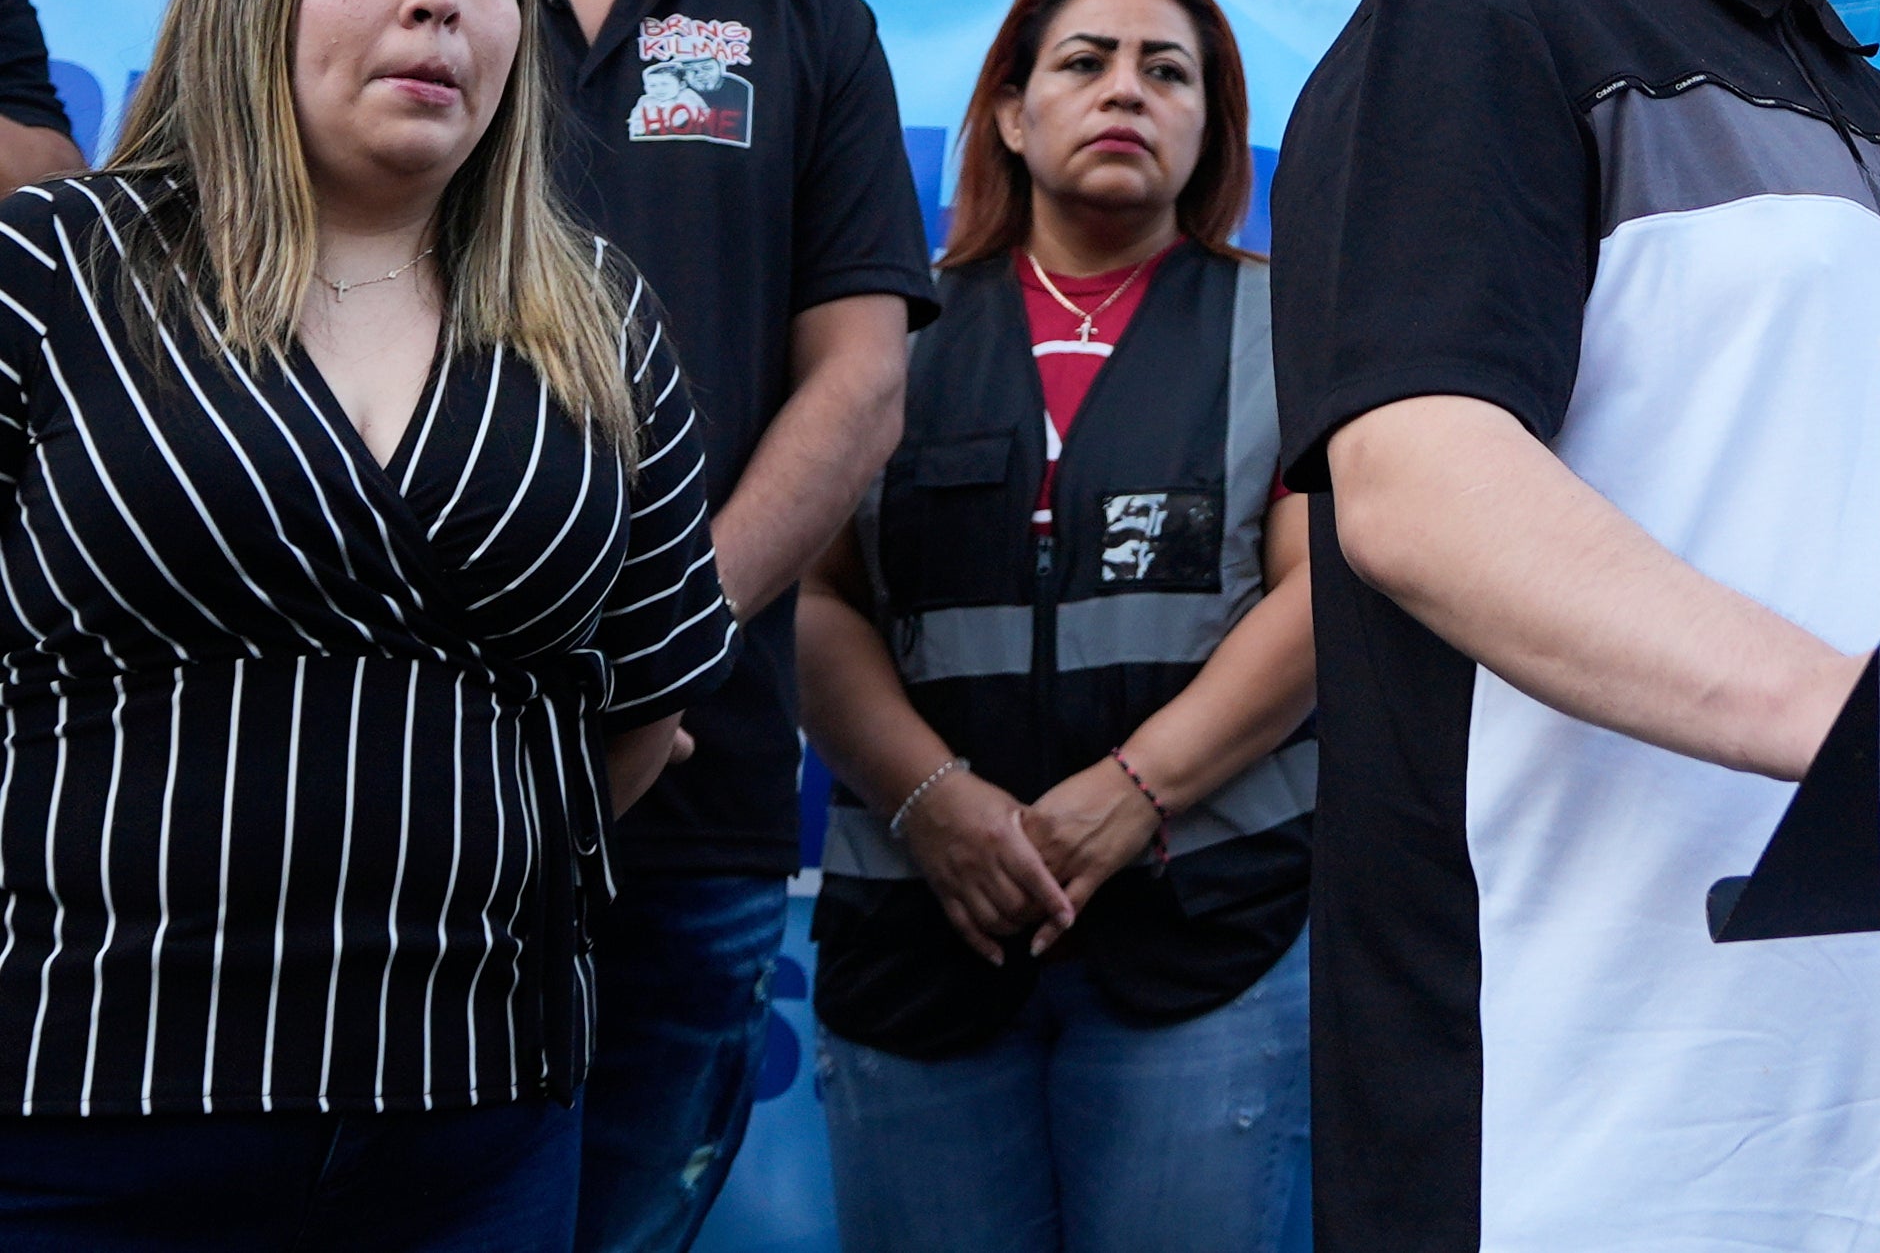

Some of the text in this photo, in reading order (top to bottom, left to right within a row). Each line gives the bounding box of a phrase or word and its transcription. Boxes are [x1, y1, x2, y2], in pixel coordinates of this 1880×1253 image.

[642, 16, 749, 40] BRING
[642, 39, 752, 63] KILMAR
[641, 103, 743, 141] HOME
